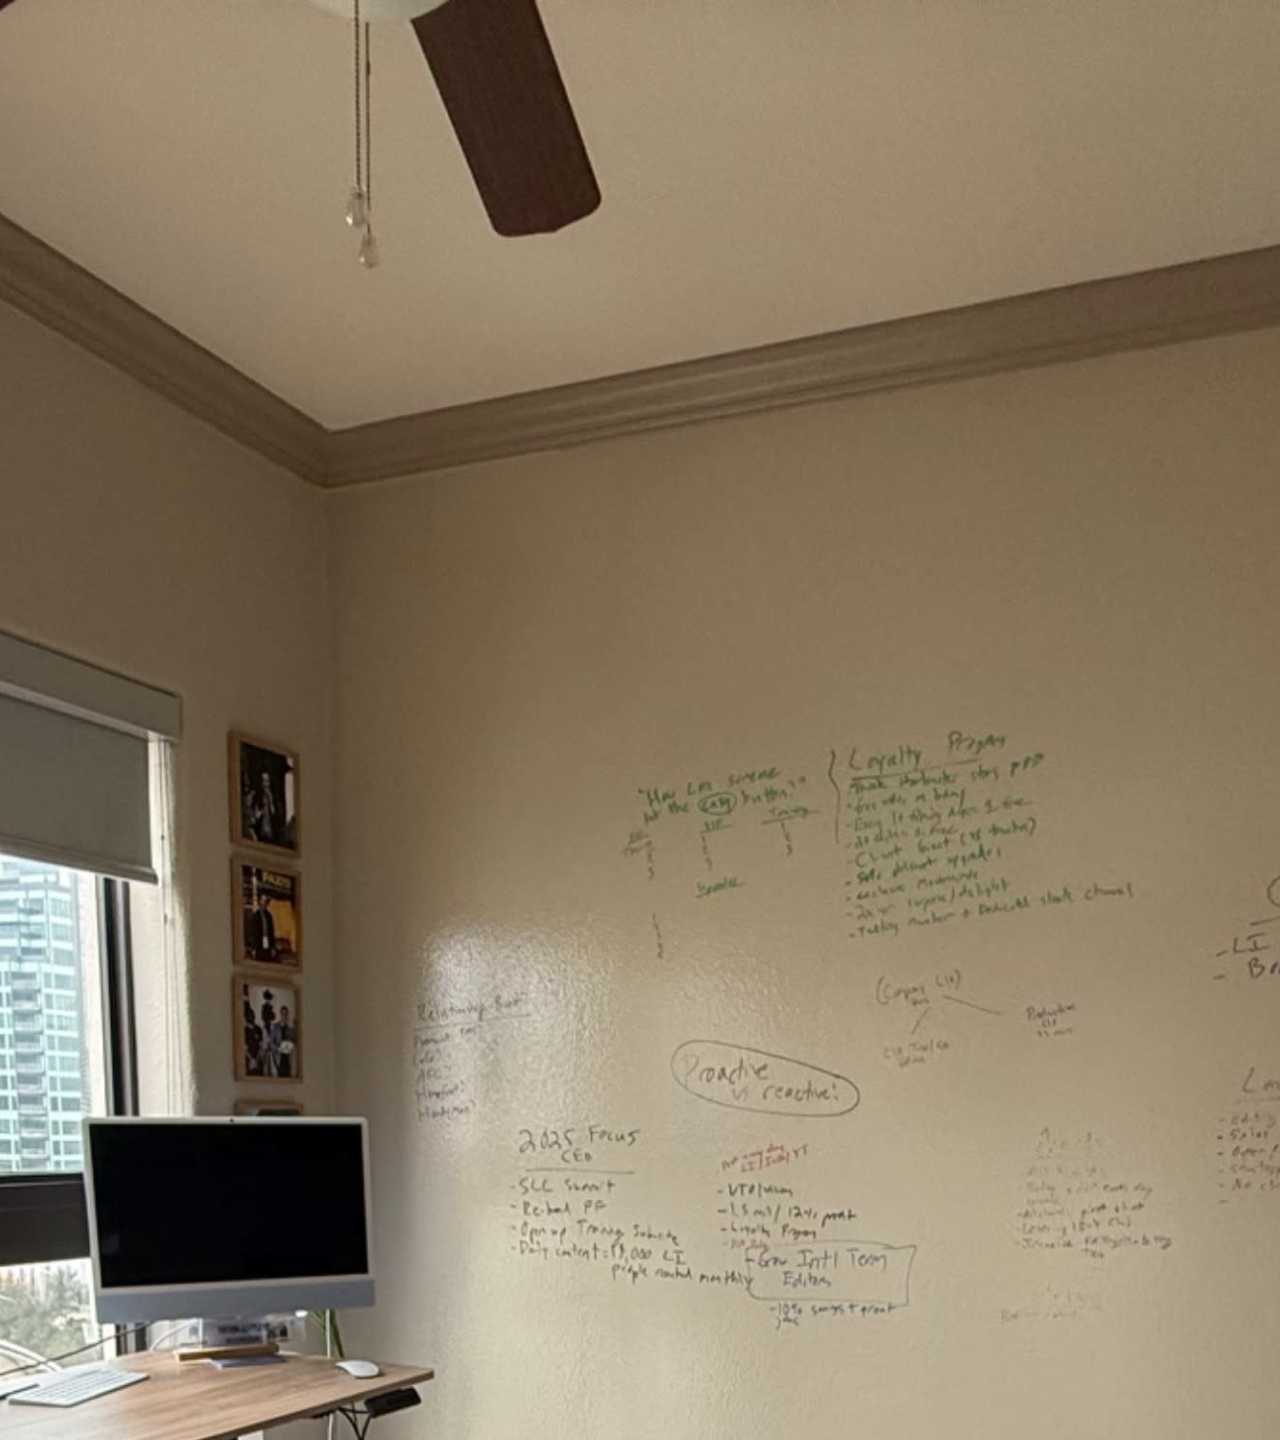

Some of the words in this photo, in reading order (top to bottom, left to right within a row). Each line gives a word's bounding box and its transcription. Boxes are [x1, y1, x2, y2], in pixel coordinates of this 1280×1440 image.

[680, 1054, 770, 1089] Proactive
[519, 1128, 576, 1154] 2025
[588, 1124, 642, 1147] Focus
[561, 1150, 594, 1163] CEO
